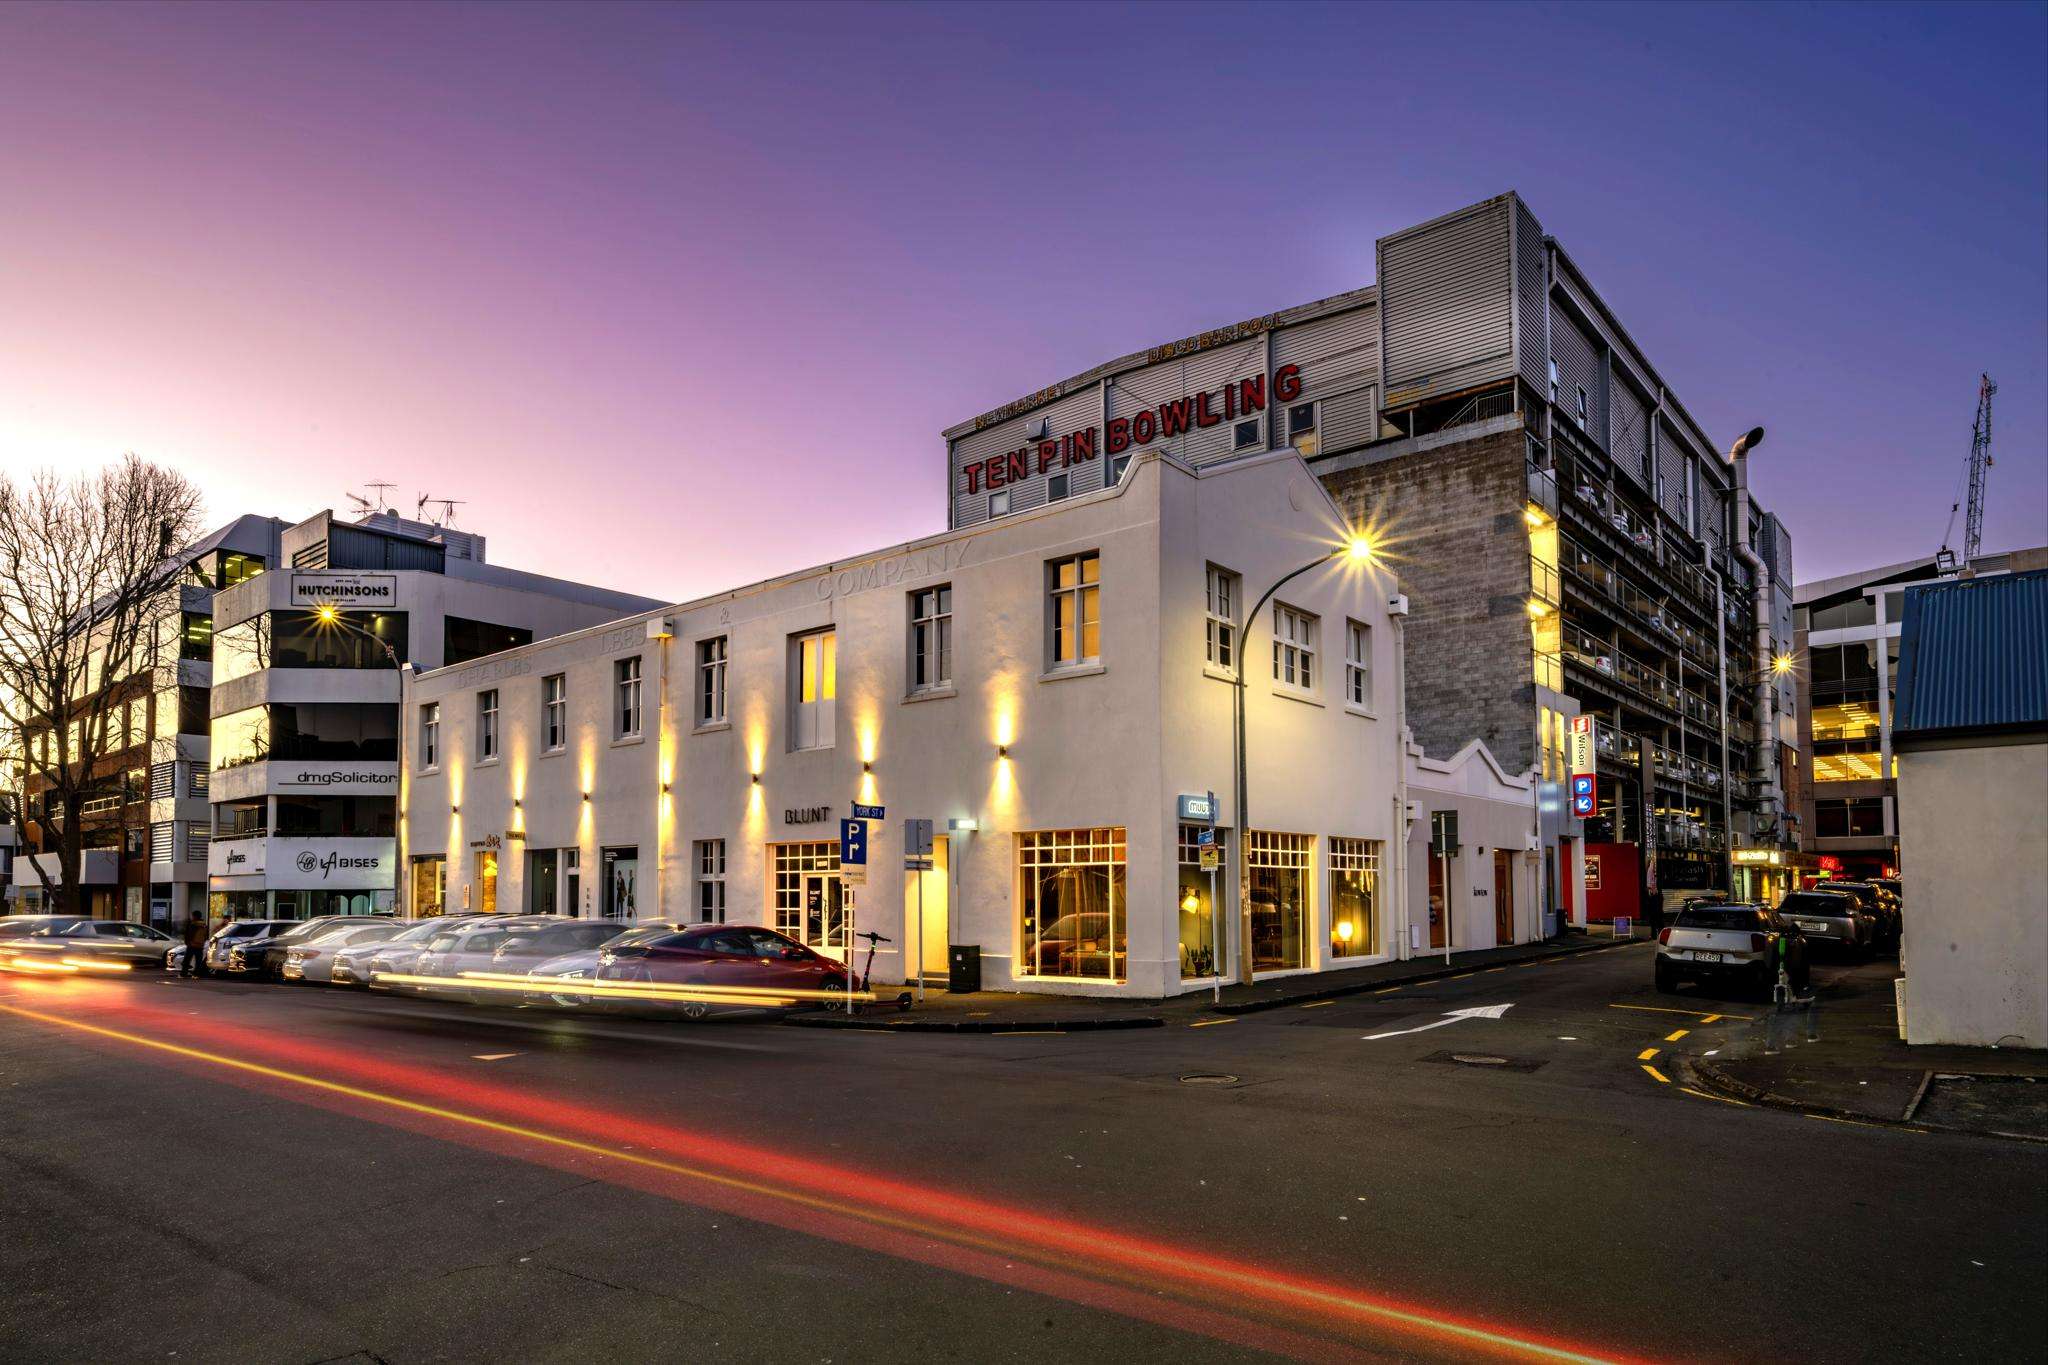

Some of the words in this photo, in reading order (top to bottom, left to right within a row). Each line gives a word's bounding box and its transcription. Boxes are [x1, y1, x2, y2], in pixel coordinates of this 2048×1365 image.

[1238, 312, 1286, 337] POOL
[964, 448, 1028, 494] TEN
[1038, 426, 1095, 474] PIN
[1106, 363, 1301, 454] BOWLING
[720, 606, 731, 625] &
[815, 538, 976, 600] COMPANY
[298, 585, 389, 596] HUTCHINSONS
[1578, 734, 1586, 766] Wilson
[297, 771, 398, 785] dmgSolicitor
[1578, 780, 1588, 792] P
[785, 806, 831, 825] BLUNT
[856, 807, 870, 816] YORK
[871, 808, 879, 817] ST
[848, 823, 860, 840] P
[339, 858, 379, 868] BISES
